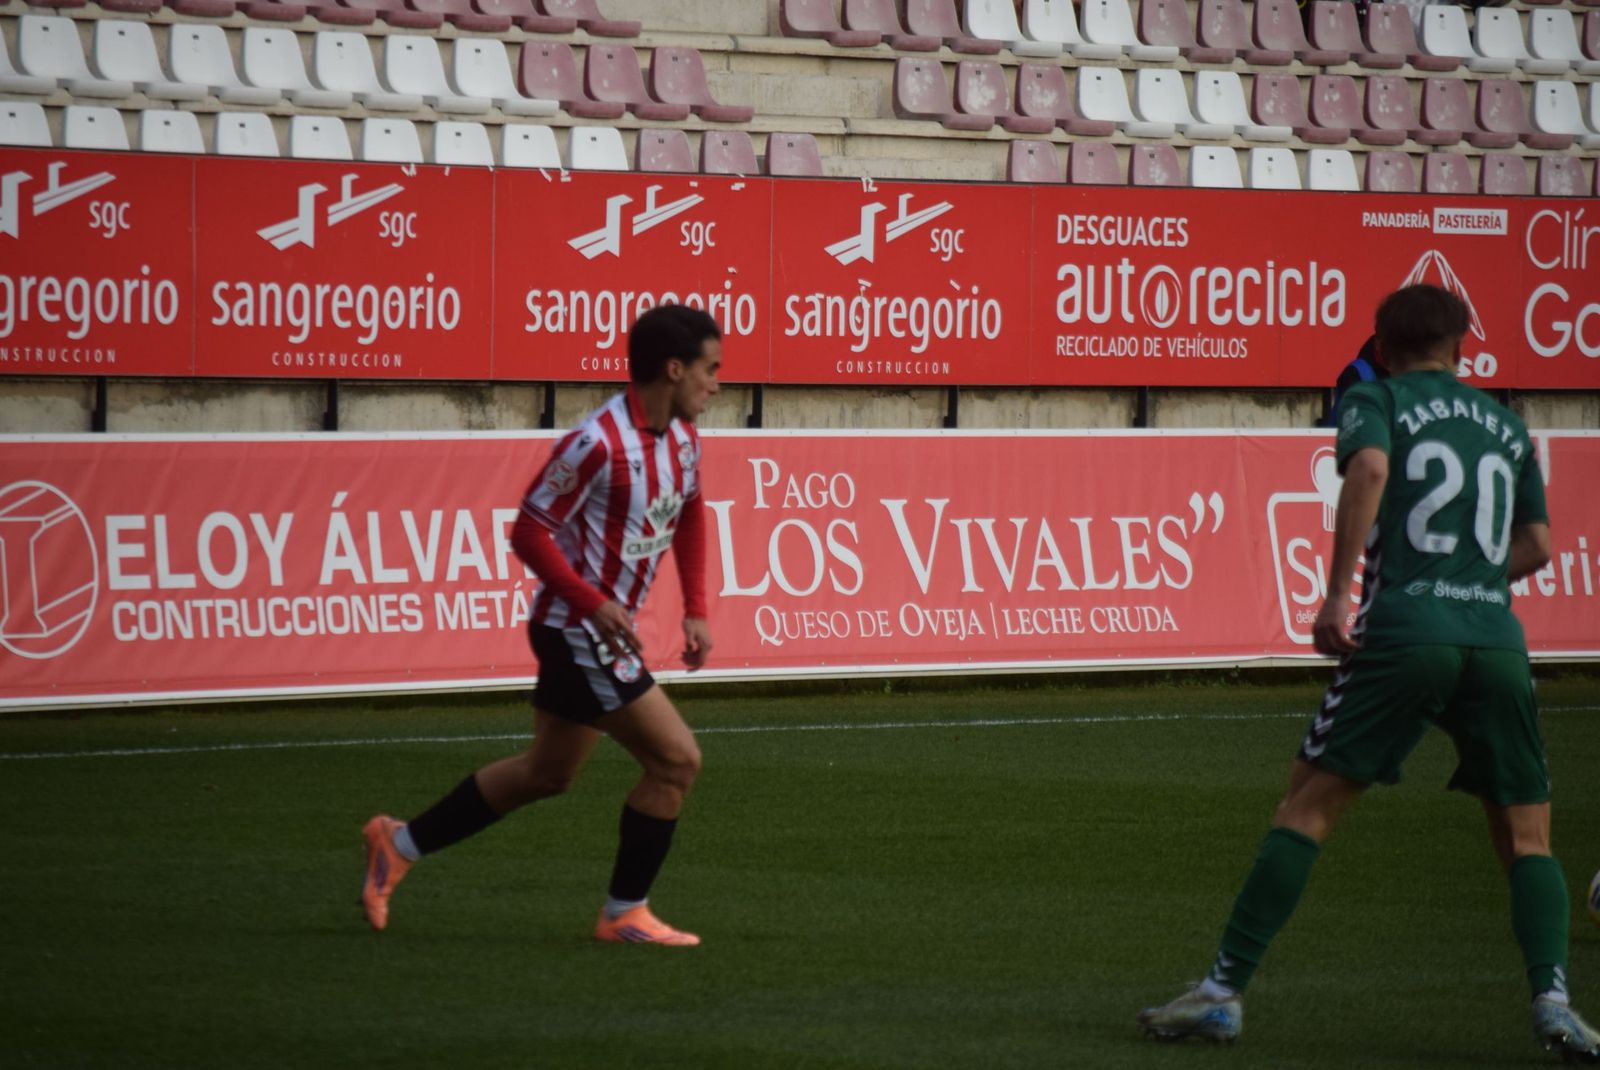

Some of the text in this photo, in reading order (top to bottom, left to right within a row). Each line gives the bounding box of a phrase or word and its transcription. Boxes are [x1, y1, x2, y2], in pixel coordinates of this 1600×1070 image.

[89, 201, 131, 239] sgc
[378, 210, 418, 248] sgc
[1056, 213, 1190, 248] DESGUACES
[1362, 209, 1503, 230] PANADERÍA PASTELERÍA
[680, 221, 717, 256] sgc
[929, 227, 965, 262] sgc
[211, 272, 462, 346] sangregorio
[784, 285, 1002, 354] sangregorio
[271, 351, 403, 368] CONSTRUCCION
[1056, 332, 1249, 359] RECICLADO DE VEHÍCULOS
[836, 360, 951, 375] CONSTRUCCION
[1398, 397, 1524, 462] ZABALETA
[1406, 440, 1514, 566] 20
[105, 511, 294, 590] ELOY
[112, 592, 424, 642] CONTRUCCIONES
[856, 610, 894, 639] DE
[1003, 607, 1086, 637] LECHE
[1088, 605, 1181, 635] CRUDA
